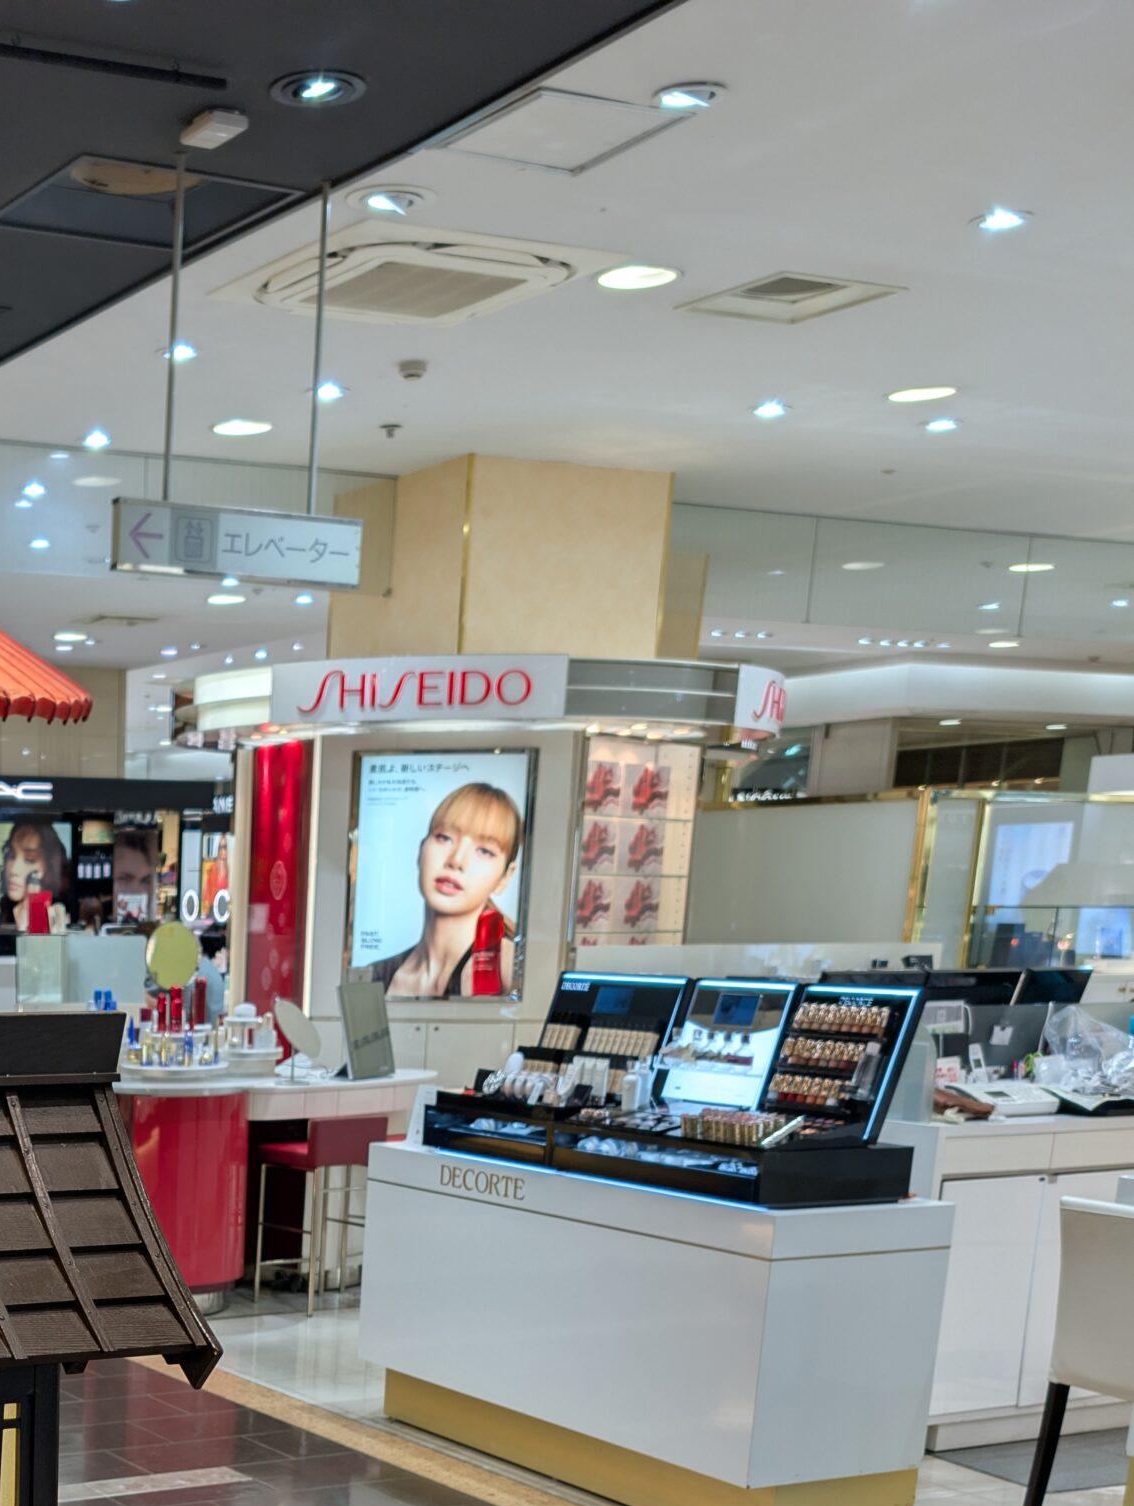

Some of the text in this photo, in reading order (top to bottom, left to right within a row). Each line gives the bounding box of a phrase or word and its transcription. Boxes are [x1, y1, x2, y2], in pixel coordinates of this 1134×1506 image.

[222, 532, 350, 563] エレベーター
[297, 669, 533, 714] SHISEIDO
[440, 1164, 526, 1201] DECORTE
